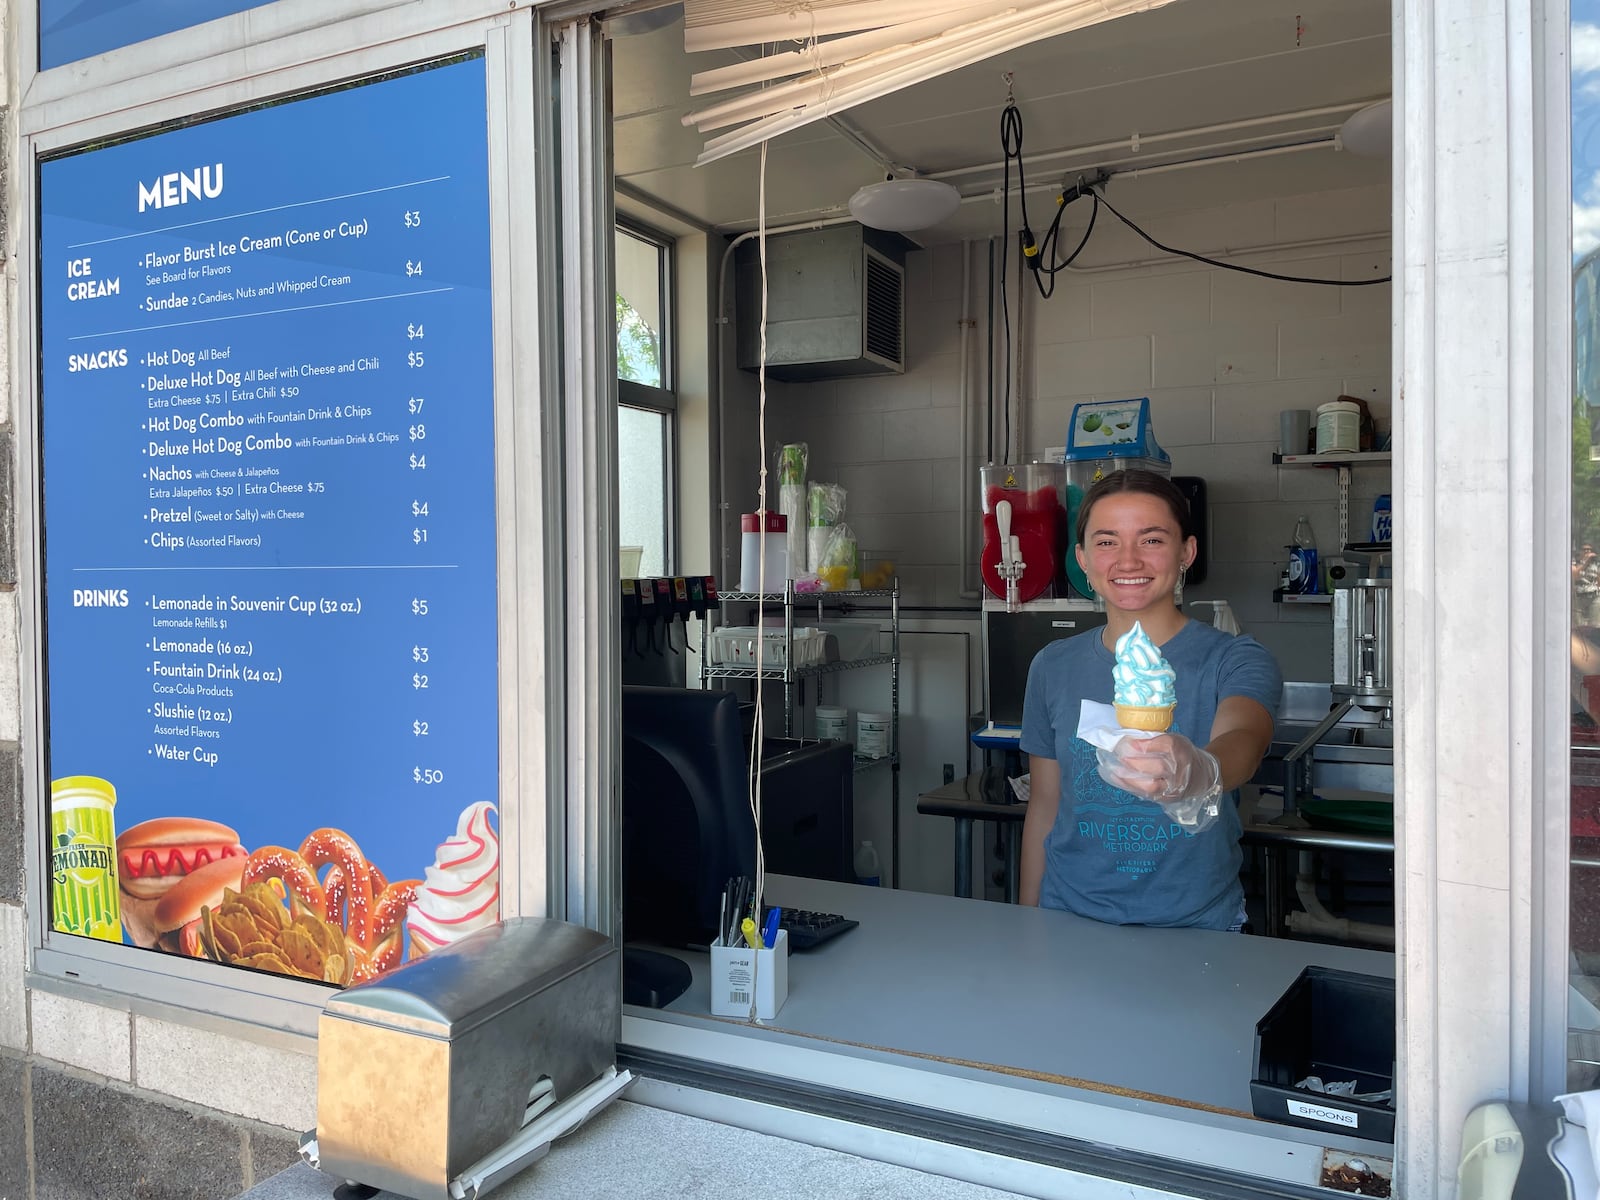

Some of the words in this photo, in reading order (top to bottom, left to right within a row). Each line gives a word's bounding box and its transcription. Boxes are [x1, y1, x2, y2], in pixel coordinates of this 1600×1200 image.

[139, 163, 223, 212] MENU
[405, 211, 420, 228] $3
[146, 252, 181, 268] Flavor
[184, 243, 215, 262] Burst
[219, 241, 236, 256] Ice
[240, 236, 282, 252] Cream
[286, 230, 320, 247] (Cone
[323, 229, 336, 239] or
[339, 219, 367, 238] Cup)
[68, 258, 91, 278] ICE
[146, 275, 161, 286] See
[163, 269, 186, 283] Board
[188, 268, 200, 279] for
[202, 265, 231, 276] Flavors
[406, 260, 422, 277] $4
[68, 277, 119, 301] CREAM
[146, 292, 188, 311] Sundae
[192, 297, 197, 305] 2
[199, 290, 234, 304] Candies,
[236, 288, 256, 298] Nuts
[258, 282, 274, 296] and
[277, 277, 316, 293] Whipped
[320, 276, 350, 287] Cream
[408, 323, 424, 340] $4
[69, 349, 128, 372] SNACKS
[148, 351, 168, 367] Hot
[172, 349, 195, 366] Dog
[198, 349, 209, 361] All
[211, 347, 230, 359] Beef
[408, 351, 424, 368] $5
[148, 374, 188, 391] Deluxe
[191, 371, 213, 387] Hot
[217, 369, 241, 386] Dog
[244, 370, 255, 381] All
[258, 367, 278, 380] Beef
[280, 366, 298, 378] with
[301, 364, 335, 376] Cheese
[338, 360, 355, 373] and
[358, 357, 379, 370] Chili
[149, 398, 169, 408] Extra
[171, 395, 201, 406] Cheese
[205, 394, 221, 404] $.75
[232, 390, 254, 401] Extra
[256, 386, 276, 399] Chili
[281, 387, 299, 398] $.50
[409, 397, 424, 414] $7
[149, 417, 170, 432] Hot
[174, 416, 196, 433] Dog
[200, 410, 244, 428] Combo
[247, 412, 265, 424] with
[268, 411, 305, 423] Fountain
[308, 407, 332, 420] Drink
[335, 407, 342, 418] &
[344, 405, 371, 418] Chips
[409, 424, 425, 442] $8
[149, 440, 189, 456] Deluxe
[193, 439, 214, 454] Hot
[218, 437, 242, 455] Dog
[246, 433, 292, 450] Combo
[295, 438, 310, 447] with
[313, 436, 344, 446] Fountain
[346, 433, 366, 444] Drink
[369, 433, 374, 443] &
[377, 432, 399, 444] Chips
[410, 453, 426, 470] $4
[150, 465, 192, 481] Nachos
[195, 470, 209, 478] with
[211, 469, 236, 478] Cheese
[238, 468, 243, 477] &
[245, 467, 279, 478] Jalapeños
[150, 488, 170, 498] Extra
[172, 486, 212, 499] Jalapeños
[216, 486, 233, 496] $.50
[245, 483, 267, 494] Extra
[270, 482, 303, 493] Cheese
[308, 482, 324, 493] $.75
[151, 506, 191, 522] Pretzel
[194, 511, 222, 523] (Sweet
[235, 509, 259, 522] Salty)
[261, 510, 275, 519] with
[277, 509, 304, 519] Cheese
[412, 500, 429, 517] $4
[151, 532, 184, 551] Chips
[187, 535, 226, 548] (Assorted
[228, 535, 261, 547] Flavors)
[413, 528, 427, 544] $1
[74, 590, 128, 607] DRINKS
[153, 595, 213, 610] Lemonade
[217, 596, 227, 610] in
[231, 596, 285, 611] Souvenir
[289, 596, 316, 616] Cup
[320, 598, 337, 613] (32
[340, 598, 361, 614] oz.)
[412, 598, 428, 615] $5
[153, 617, 193, 627] Lemonade
[195, 617, 218, 628] Refills
[220, 619, 227, 629] $1
[153, 637, 214, 653] Lemonade
[217, 640, 231, 655] (16
[234, 641, 252, 656] oz.)
[413, 645, 428, 662] $3
[154, 661, 204, 677] Fountain
[208, 663, 240, 679] Drink
[243, 666, 260, 682] (24
[263, 668, 282, 683] oz.)
[153, 682, 195, 694] Coca-Cola
[197, 685, 233, 696] Products
[413, 673, 428, 690] $2
[154, 702, 194, 719] Slushie
[198, 707, 211, 721] (12
[214, 708, 232, 723] oz.)
[154, 724, 189, 736] Assorted
[191, 726, 220, 738] Flavors
[413, 720, 428, 736] $2
[155, 744, 190, 760] Water
[193, 747, 218, 767] Cup
[414, 766, 443, 784] $.50
[1102, 841, 1168, 853] METROPARK
[52, 846, 114, 877] EMONADE
[1299, 1106, 1353, 1123] SPOONS
